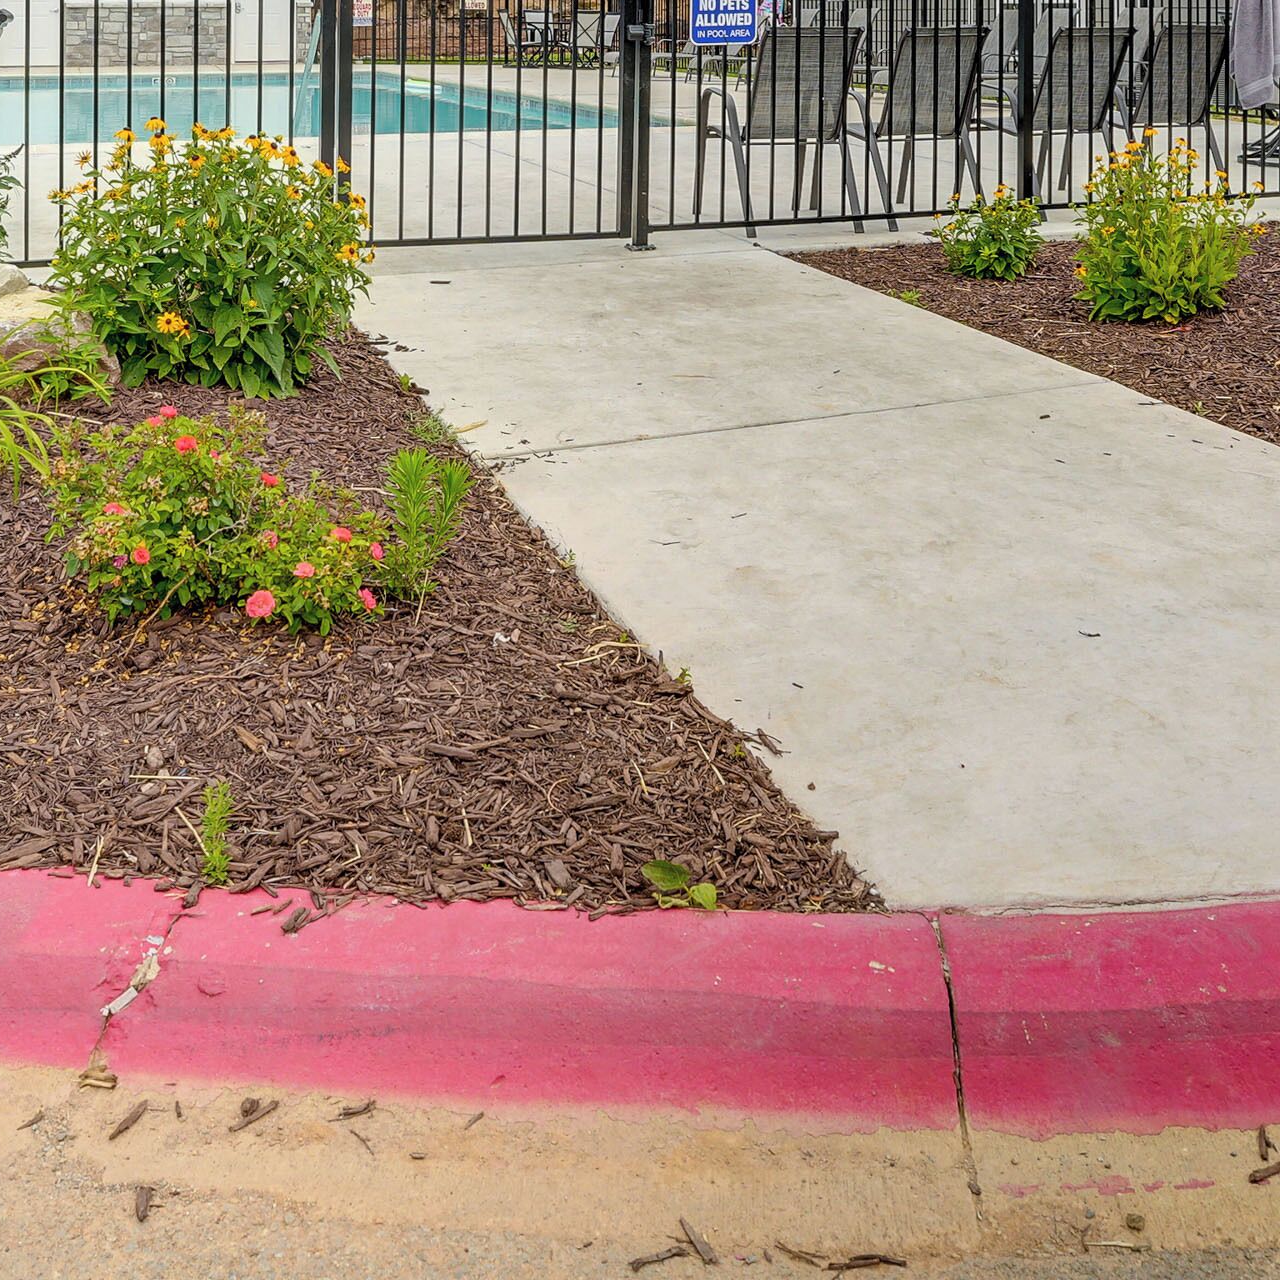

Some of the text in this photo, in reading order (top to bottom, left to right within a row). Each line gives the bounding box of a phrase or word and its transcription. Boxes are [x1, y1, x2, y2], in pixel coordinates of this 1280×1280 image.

[695, 12, 753, 27] ALLOWED
[697, 29, 751, 38] IN POOL AREA
